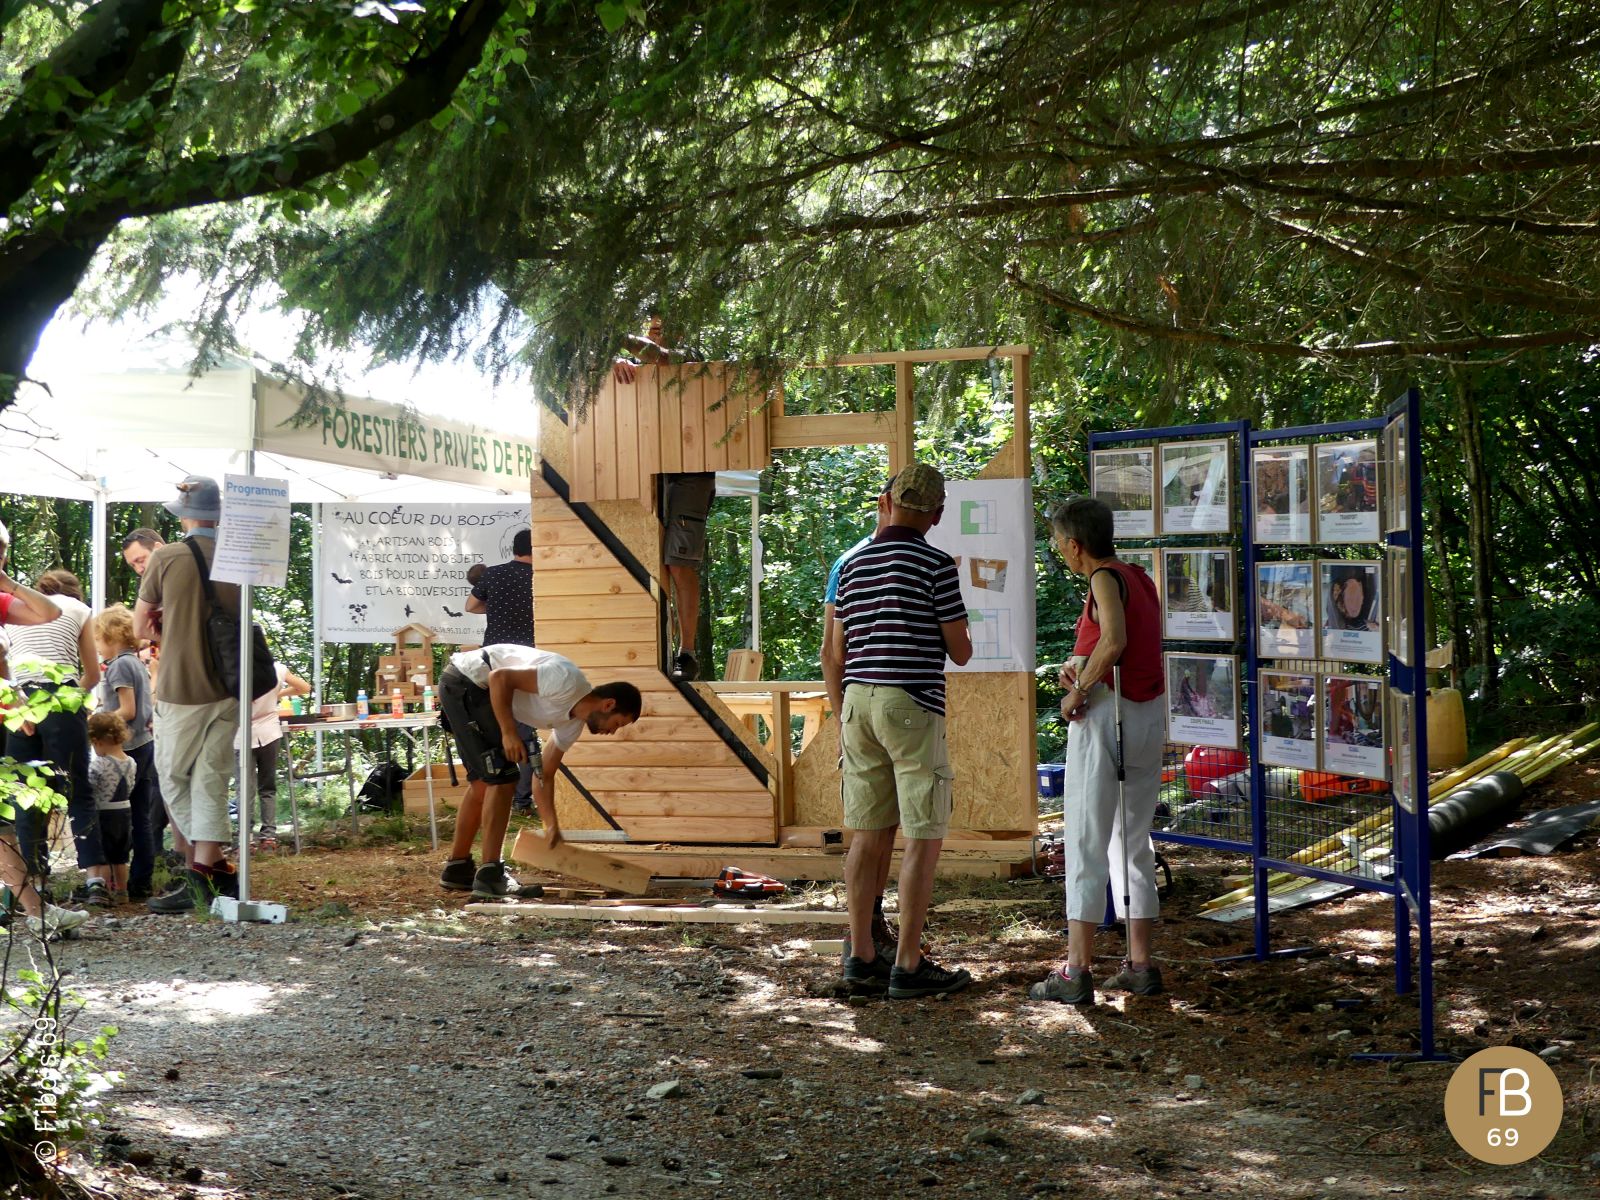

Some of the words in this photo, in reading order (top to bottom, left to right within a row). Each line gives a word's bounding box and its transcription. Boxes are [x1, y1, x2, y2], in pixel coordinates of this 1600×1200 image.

[322, 406, 428, 462] FORESTIERS
[433, 424, 488, 472] PRIVÉS
[492, 439, 513, 476] DE
[226, 482, 287, 497] Programme
[343, 511, 364, 525] AU
[430, 514, 452, 526] DU
[457, 514, 497, 527] BOIS
[376, 536, 425, 547] ARTISAN
[354, 552, 430, 563] FABRICATION
[359, 569, 384, 580] BOIS
[386, 568, 416, 580] POUR
[417, 569, 430, 580] LE
